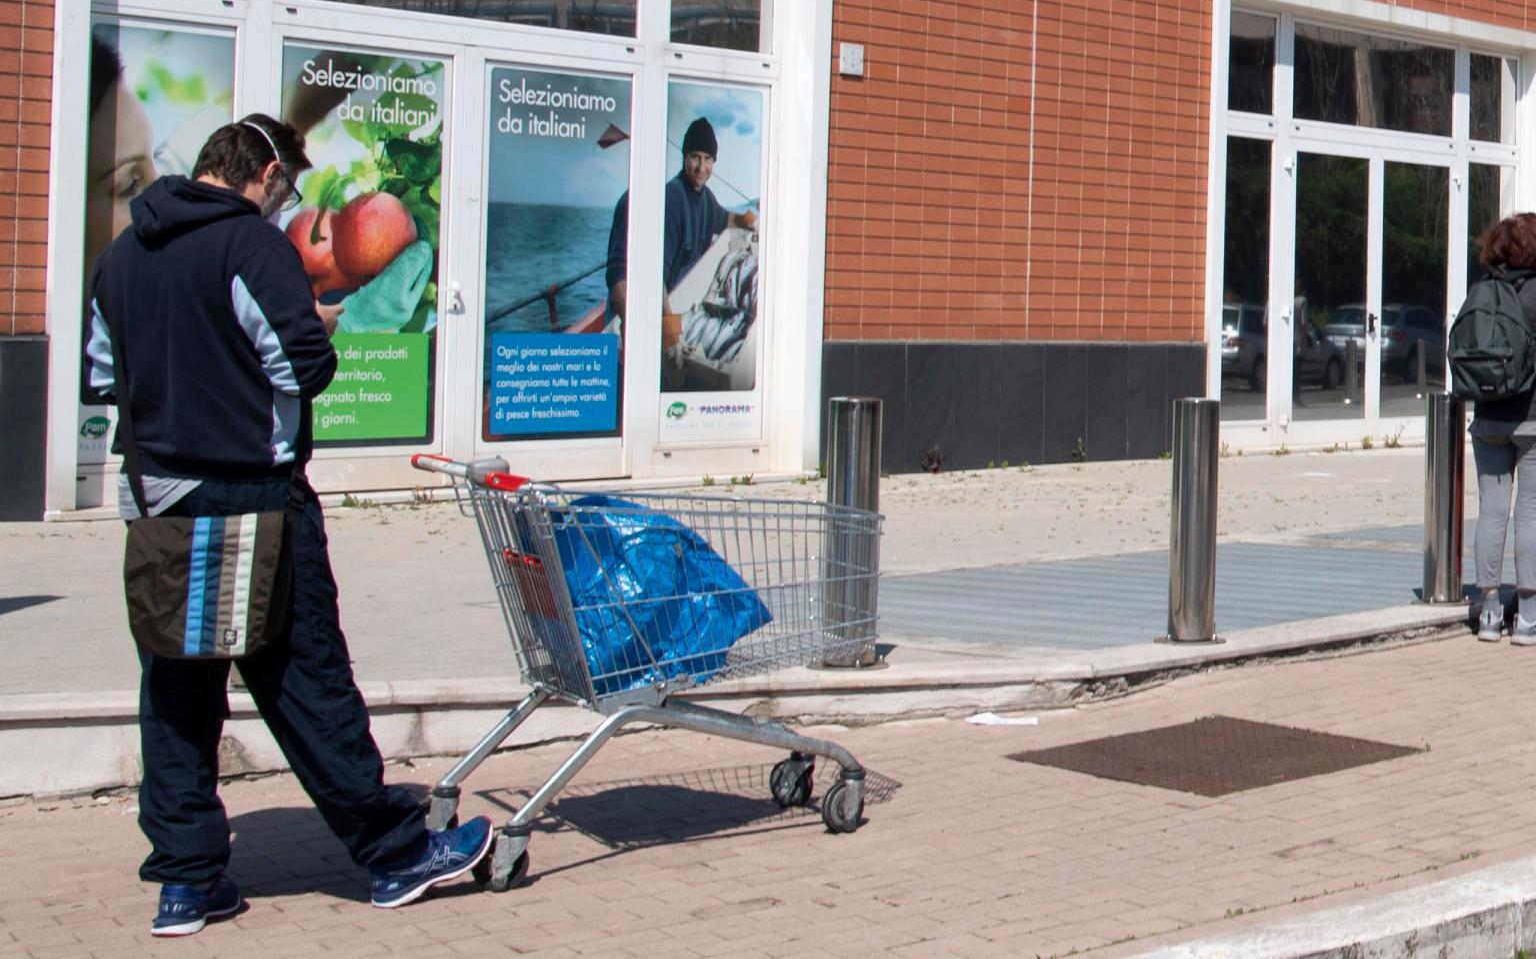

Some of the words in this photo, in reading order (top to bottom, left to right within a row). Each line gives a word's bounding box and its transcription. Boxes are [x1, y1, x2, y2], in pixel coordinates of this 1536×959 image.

[302, 58, 437, 97] Selezioniamo
[499, 78, 617, 113] Selezioniamo
[337, 93, 364, 122] da
[371, 97, 437, 128] italiani
[498, 107, 523, 135] da
[528, 110, 586, 139] italiani
[344, 345, 362, 360] dei
[365, 345, 408, 363] prodotti
[496, 345, 519, 359] Ogni
[520, 346, 548, 359] giorno
[549, 345, 601, 356] selezioniamo
[603, 345, 608, 356] il
[334, 368, 386, 383] territorio,
[496, 361, 525, 375] meglio
[526, 361, 540, 372] dei
[542, 362, 565, 372] nostri
[566, 362, 585, 372] mari
[593, 360, 601, 372] lo
[496, 378, 550, 390] consegniamo
[552, 376, 569, 387] tutte
[571, 375, 578, 387] le
[580, 377, 611, 388] mattine,
[312, 391, 356, 407] egnato
[359, 387, 392, 402] fresco
[495, 395, 509, 407] per
[512, 392, 538, 403] offrirti
[540, 392, 578, 404] un'ampia
[579, 391, 607, 402] varietà
[495, 408, 504, 420] di
[506, 410, 530, 423] pesce
[531, 405, 581, 419] freschissimo.
[699, 404, 751, 415] PANORAMA
[83, 422, 107, 434] Pam
[321, 411, 359, 428] giorni.
